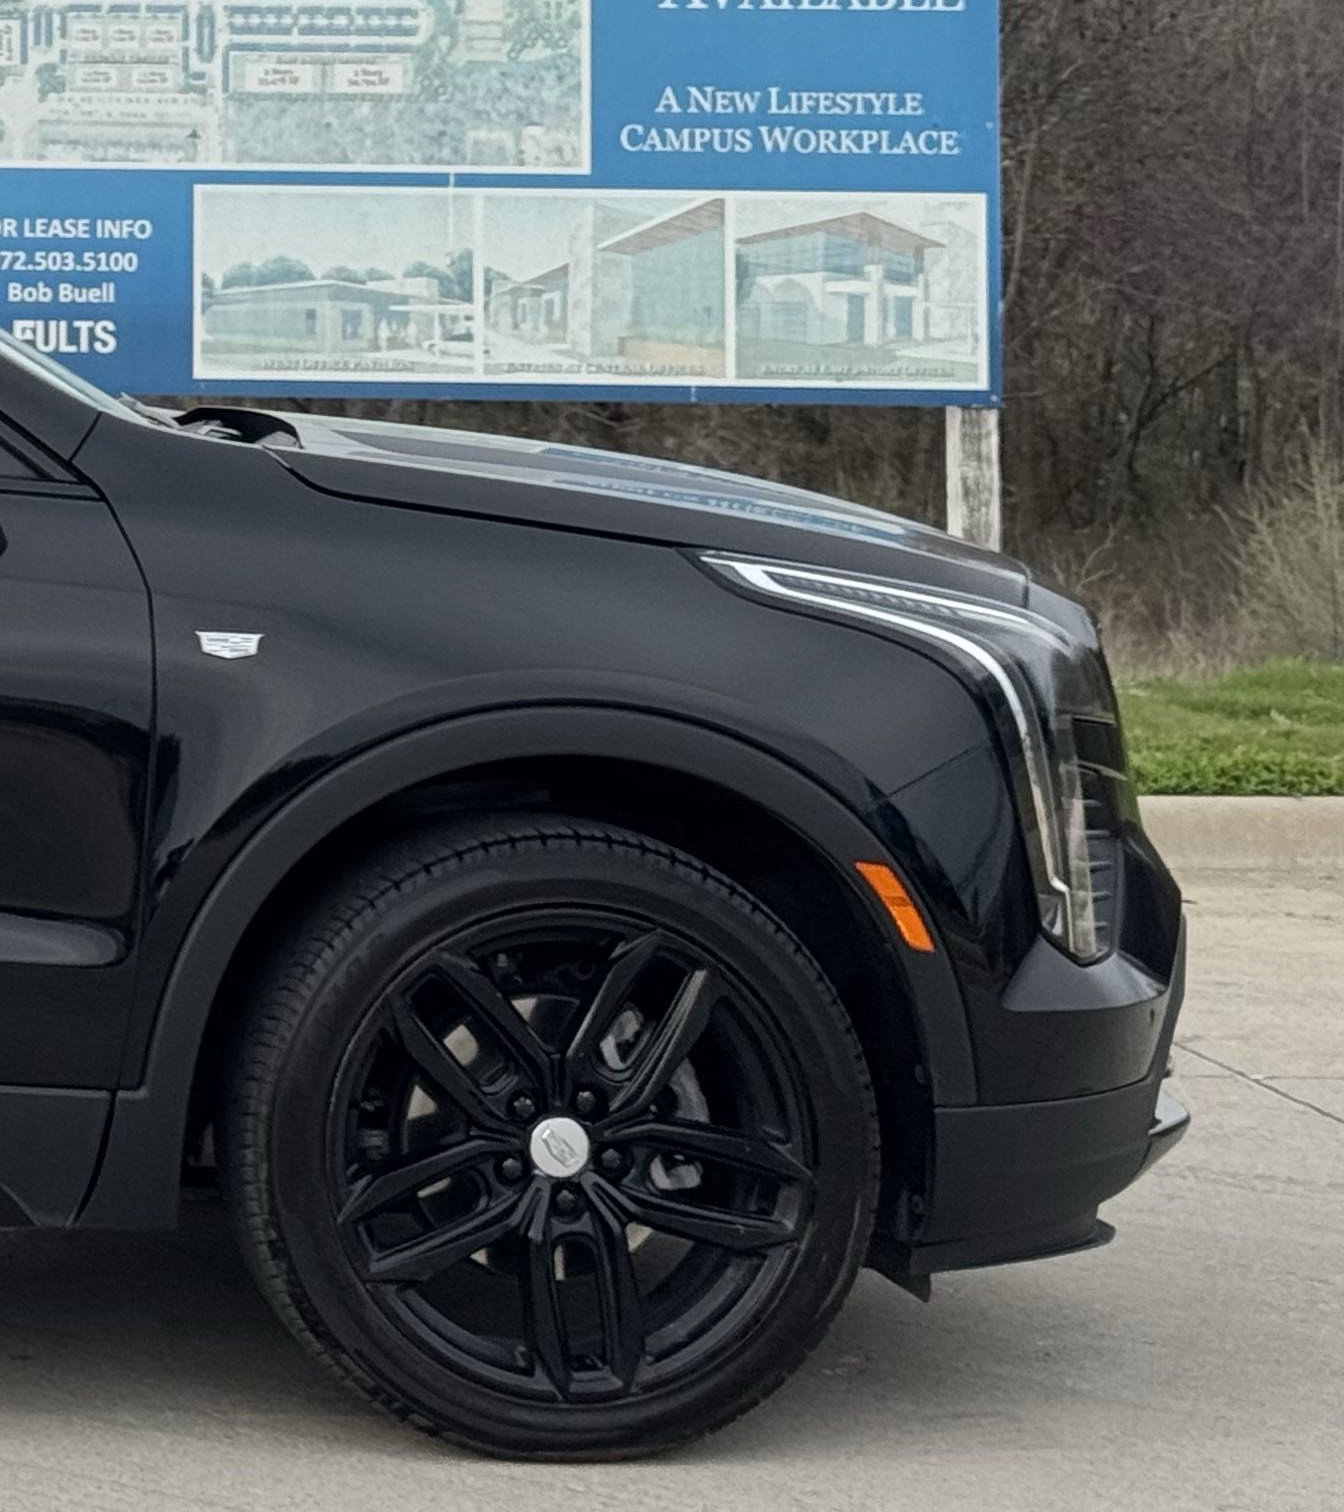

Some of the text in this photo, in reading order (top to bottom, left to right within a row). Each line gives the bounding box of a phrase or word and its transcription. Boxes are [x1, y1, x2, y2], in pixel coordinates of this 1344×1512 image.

[654, 88, 680, 114] A
[23, 218, 90, 238] LEASE
[96, 219, 153, 239] INFO
[7, 282, 116, 303] Bob Buell
[13, 320, 117, 354] FULTS
